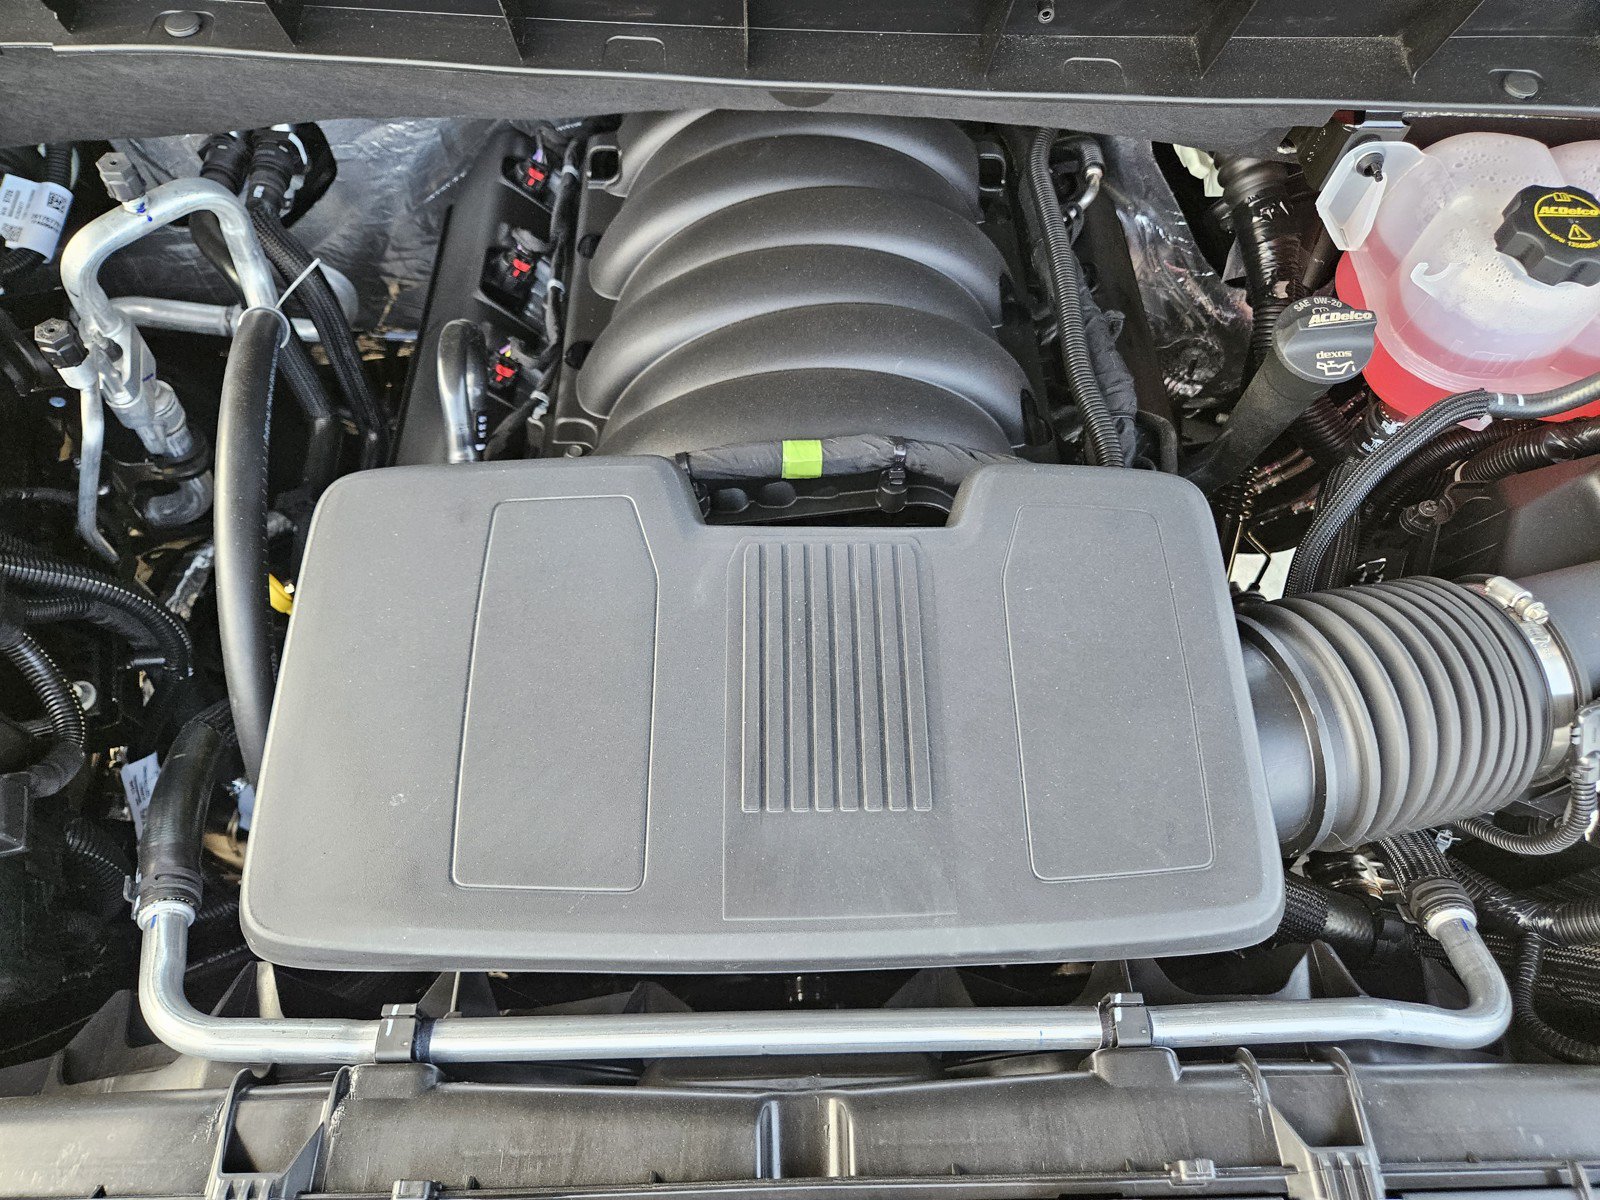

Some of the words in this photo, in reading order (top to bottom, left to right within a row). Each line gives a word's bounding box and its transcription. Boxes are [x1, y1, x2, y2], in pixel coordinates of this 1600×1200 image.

[1539, 206, 1599, 216] ACDelco
[1293, 299, 1311, 312] SAE
[1313, 297, 1343, 308] 0W-20
[1308, 311, 1373, 325] ACDelco
[1316, 350, 1352, 360] dexos
